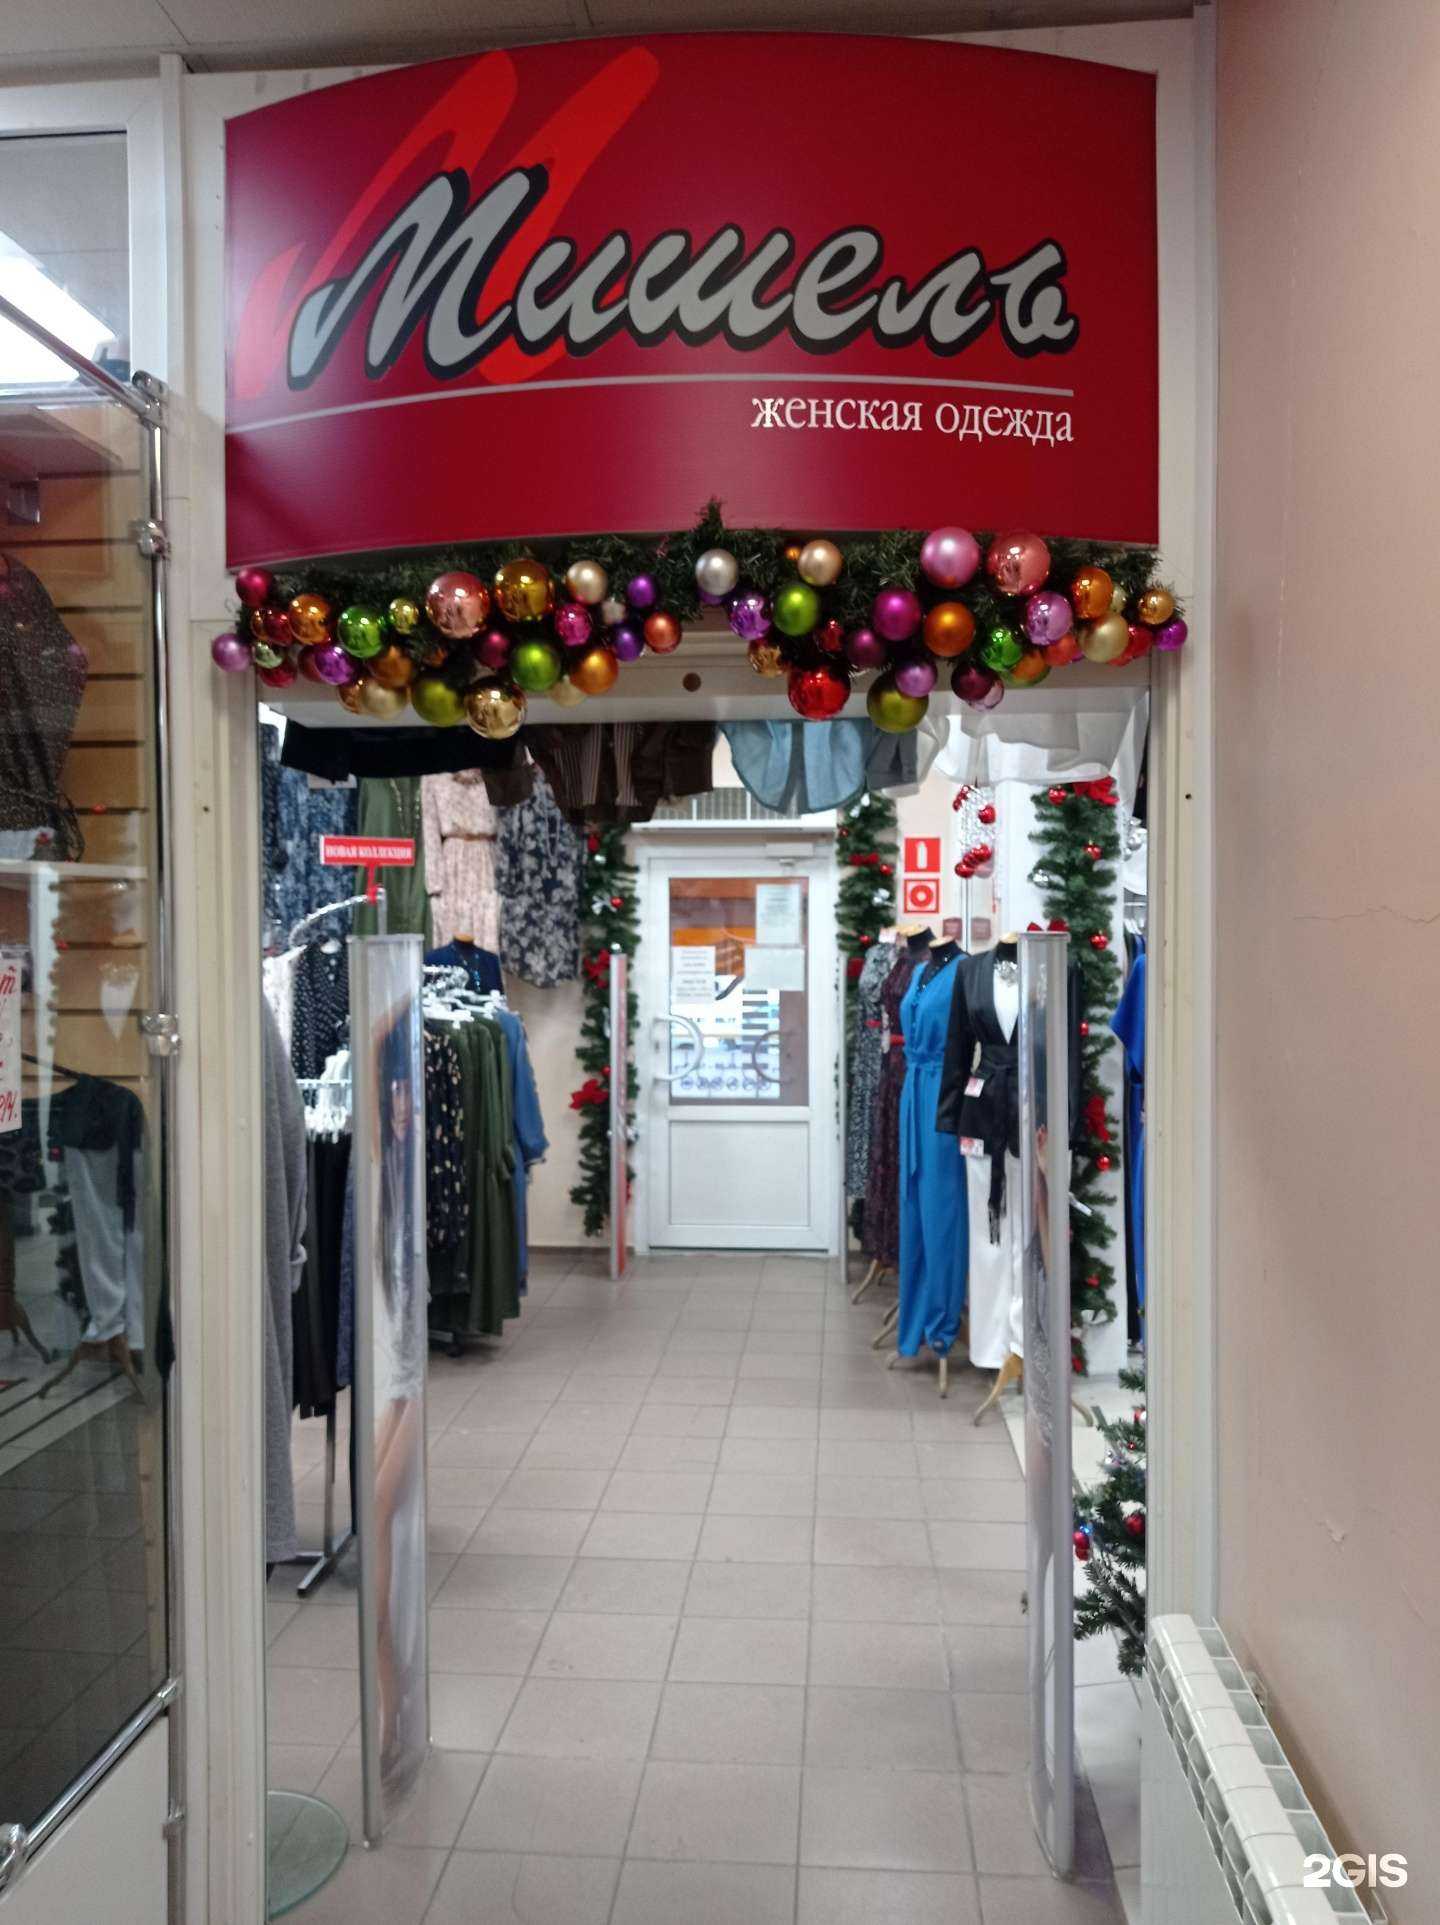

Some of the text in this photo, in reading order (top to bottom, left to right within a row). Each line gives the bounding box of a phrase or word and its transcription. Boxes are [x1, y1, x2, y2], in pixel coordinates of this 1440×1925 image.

[287, 165, 1078, 389] Мишель
[750, 397, 1074, 447] женская одежда
